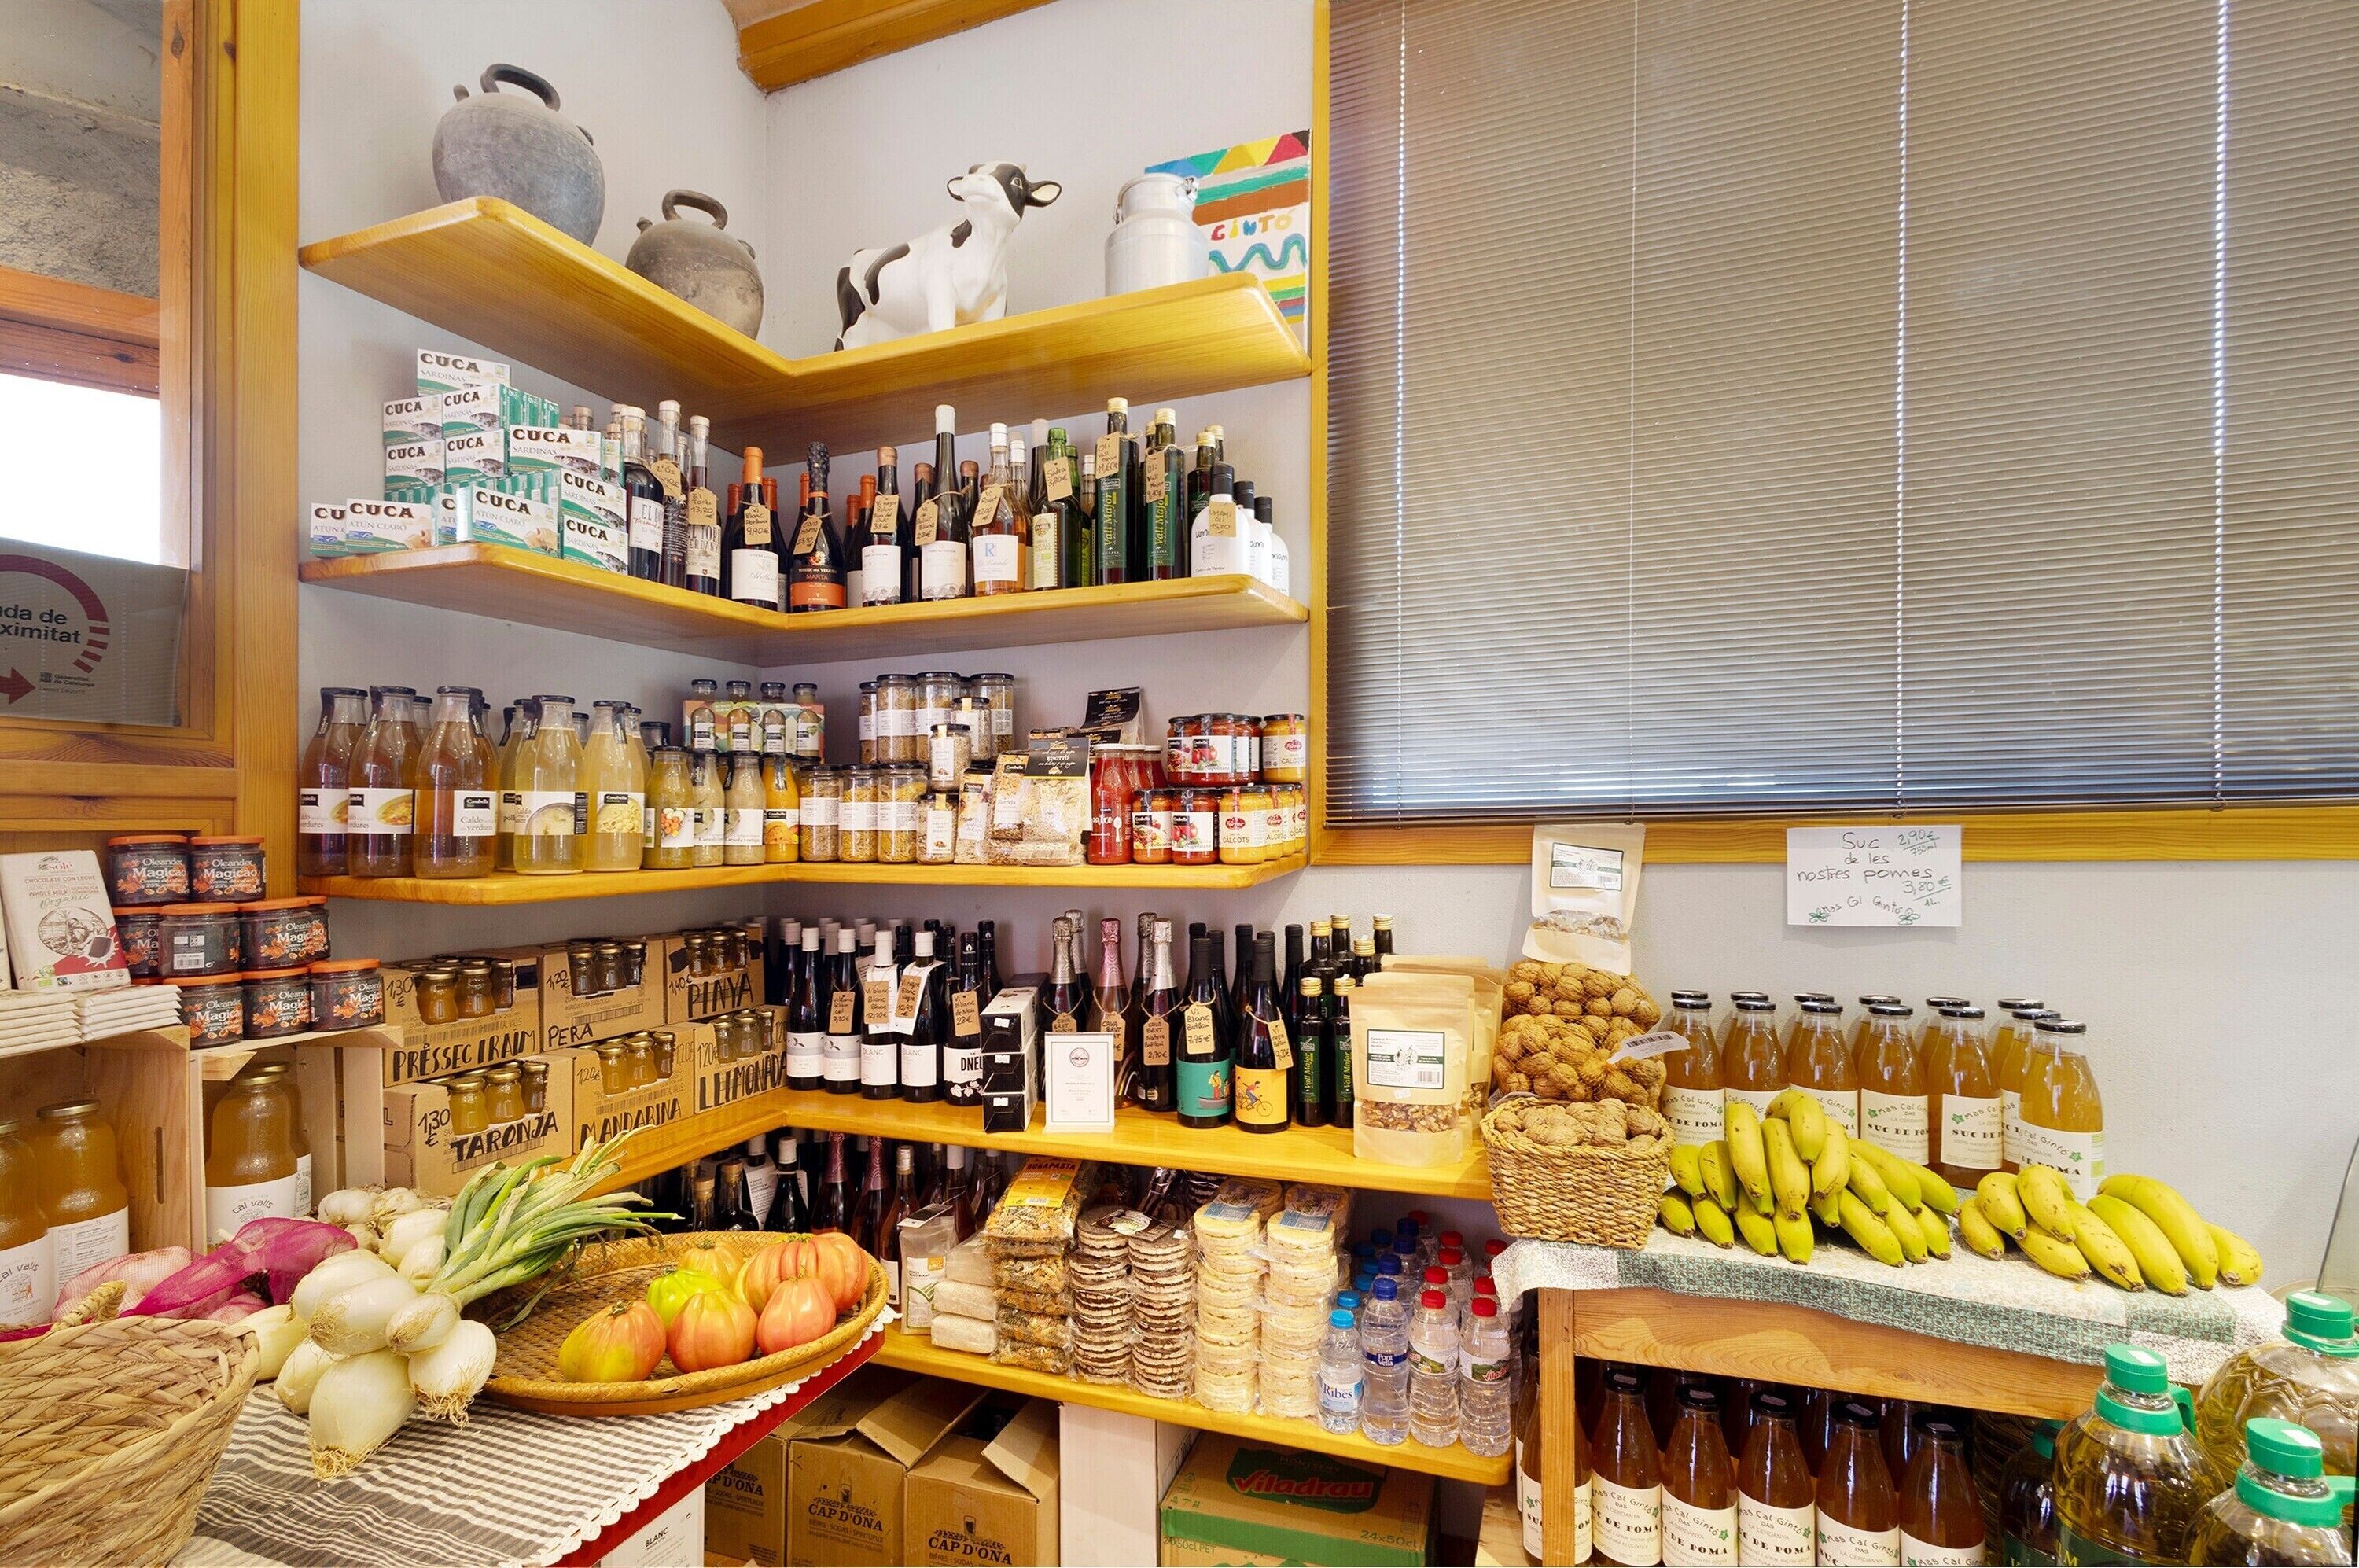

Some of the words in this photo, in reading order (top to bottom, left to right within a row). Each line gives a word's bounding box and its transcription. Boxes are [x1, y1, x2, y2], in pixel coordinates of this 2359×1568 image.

[420, 352, 480, 373] CUCA
[421, 369, 466, 383] SARDINAS
[443, 390, 480, 407] CUCA
[385, 401, 423, 416] CUCA
[447, 436, 484, 452] CUCA
[512, 429, 571, 444] CUCA
[388, 446, 426, 461] CUCA
[513, 445, 558, 455] SARDINAS
[563, 473, 606, 497] CUCA
[475, 491, 532, 515] CUCA
[564, 489, 596, 506] SARDINAS
[349, 502, 414, 519] CUCA
[1104, 493, 1115, 521] Major
[376, 522, 407, 531] CLARO
[566, 519, 609, 541] CUCA
[1104, 522, 1114, 545] Vall
[1155, 522, 1165, 545] Vall
[566, 536, 599, 550] SARDINAS
[39, 609, 68, 625] de
[142, 857, 182, 867] Oleander
[212, 859, 253, 867] Oleander
[1845, 852, 1857, 865] de
[1869, 853, 1890, 865] les
[132, 867, 186, 879] Magicao
[204, 868, 258, 880] Magicao
[1796, 864, 1851, 882] nostres
[1863, 867, 1934, 884] pomes
[1902, 879, 1935, 896] 3,80
[39, 894, 90, 909] Organic
[387, 977, 414, 999] 1,30
[686, 973, 753, 1018] PINYA
[396, 998, 406, 1007] €
[548, 1023, 594, 1047] PERA
[1305, 1053, 1313, 1070] Major
[1344, 1052, 1352, 1071] Major
[699, 1051, 787, 1110] LLIMONADA
[1305, 1071, 1313, 1088] Vall
[1344, 1072, 1352, 1088] Vall
[1680, 1094, 1695, 1102] Cal
[1878, 1103, 1897, 1114] Mas
[1963, 1109, 1985, 1120] Mas
[418, 1108, 451, 1136] 1,30
[580, 1098, 682, 1150] MANDARINA
[1868, 1124, 1890, 1134] SUC
[1894, 1127, 1909, 1136] DE
[425, 1133, 440, 1147] €
[450, 1110, 559, 1162] TARONJA
[1952, 1128, 1977, 1139] SUC
[2041, 1136, 2070, 1156] Gintó
[232, 1199, 249, 1215] cal
[250, 1198, 274, 1209] valls
[17, 1261, 39, 1272] valls
[1323, 1382, 1353, 1400] Ribes
[723, 1475, 764, 1496] D'ONA
[1231, 1469, 1375, 1500] Viladrau
[1610, 1491, 1627, 1502] Cal
[1629, 1498, 1653, 1515] Gintó
[808, 1503, 837, 1519] CAP
[839, 1508, 884, 1532] D'ONA
[1606, 1517, 1621, 1528] DE
[1625, 1524, 1658, 1533] POMA
[1675, 1509, 1690, 1522] Cal
[1693, 1517, 1720, 1536] Gintó
[1755, 1511, 1773, 1522] Cal
[1777, 1518, 1803, 1535] Gintó
[645, 1526, 668, 1548] BLANC
[1361, 1529, 1417, 1548] 24x50cl
[1671, 1533, 1684, 1544] DE
[1690, 1541, 1728, 1555] POMA
[928, 1536, 959, 1553] CAP
[962, 1542, 1013, 1566] D'ONA
[1198, 1544, 1216, 1555] PET
[1753, 1538, 1769, 1551] DE
[1775, 1544, 1811, 1555] POMA
[1827, 1535, 1846, 1544] Mas
[1849, 1537, 1868, 1548] Cal
[1872, 1541, 1894, 1557] Gintó
[953, 1557, 973, 1566] SODAS
[1917, 1557, 1938, 1566] Mas
[1942, 1556, 1961, 1566] Cal
